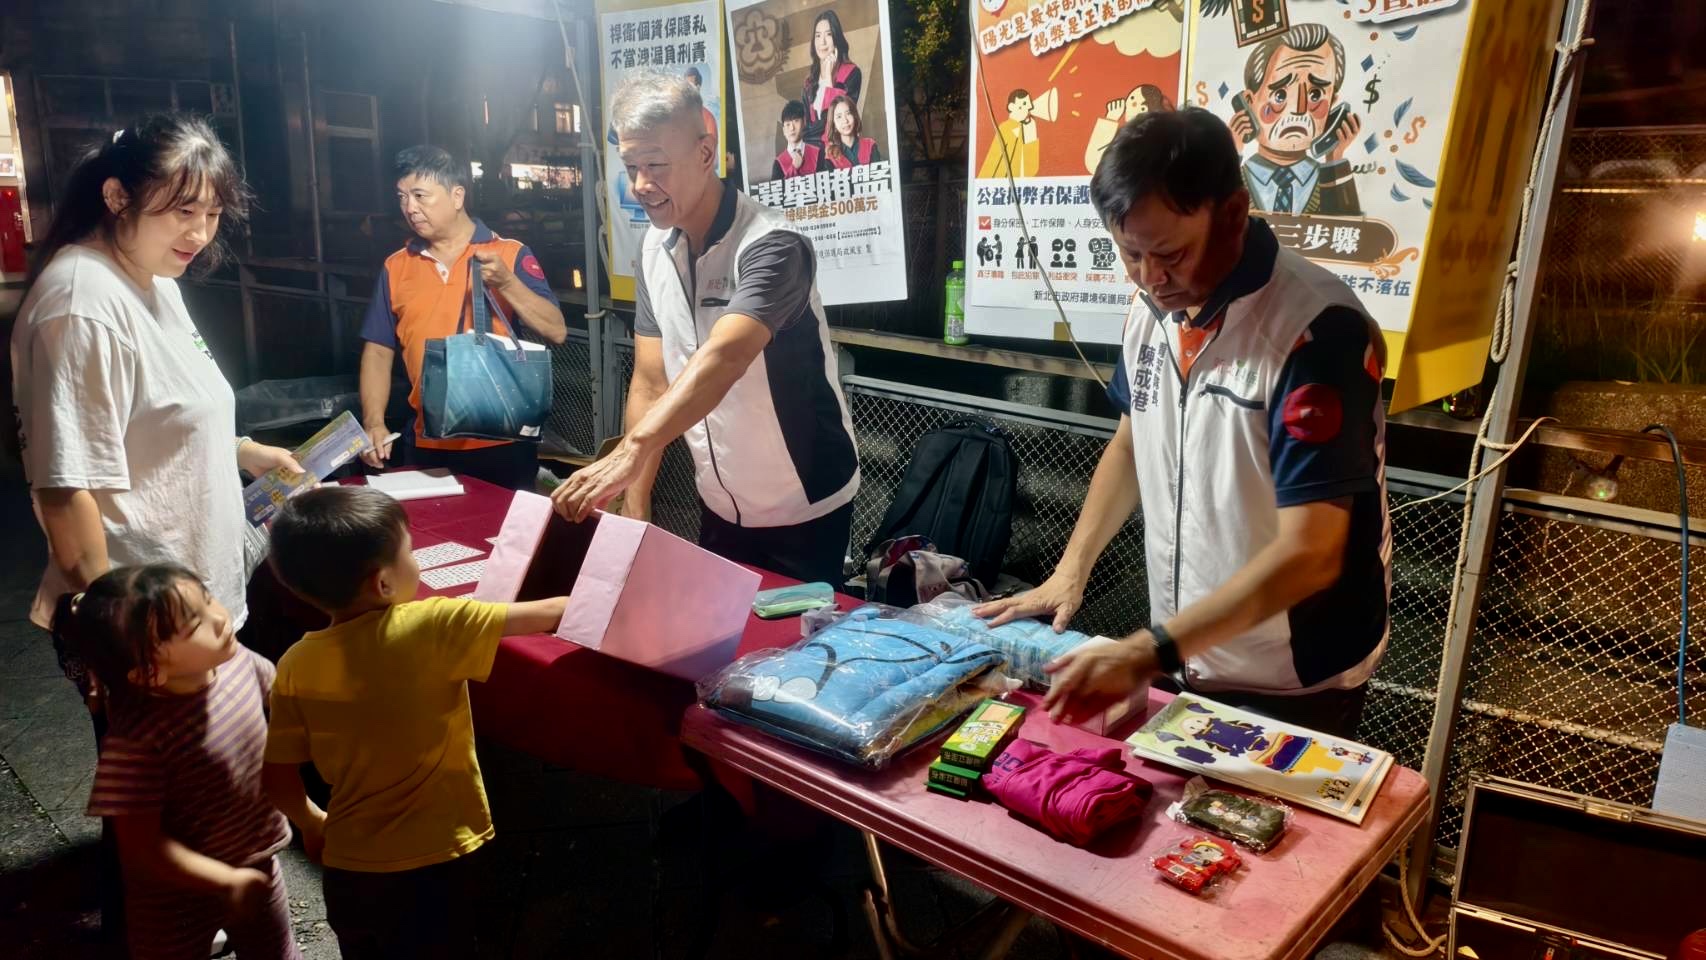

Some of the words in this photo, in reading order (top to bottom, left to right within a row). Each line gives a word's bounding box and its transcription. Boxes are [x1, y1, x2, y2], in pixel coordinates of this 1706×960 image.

[983, 0, 1092, 49] 陽光是最好的
[1033, 0, 1152, 50] 揭弊是正義的
[610, 40, 706, 69] 不當洩漏負刑責
